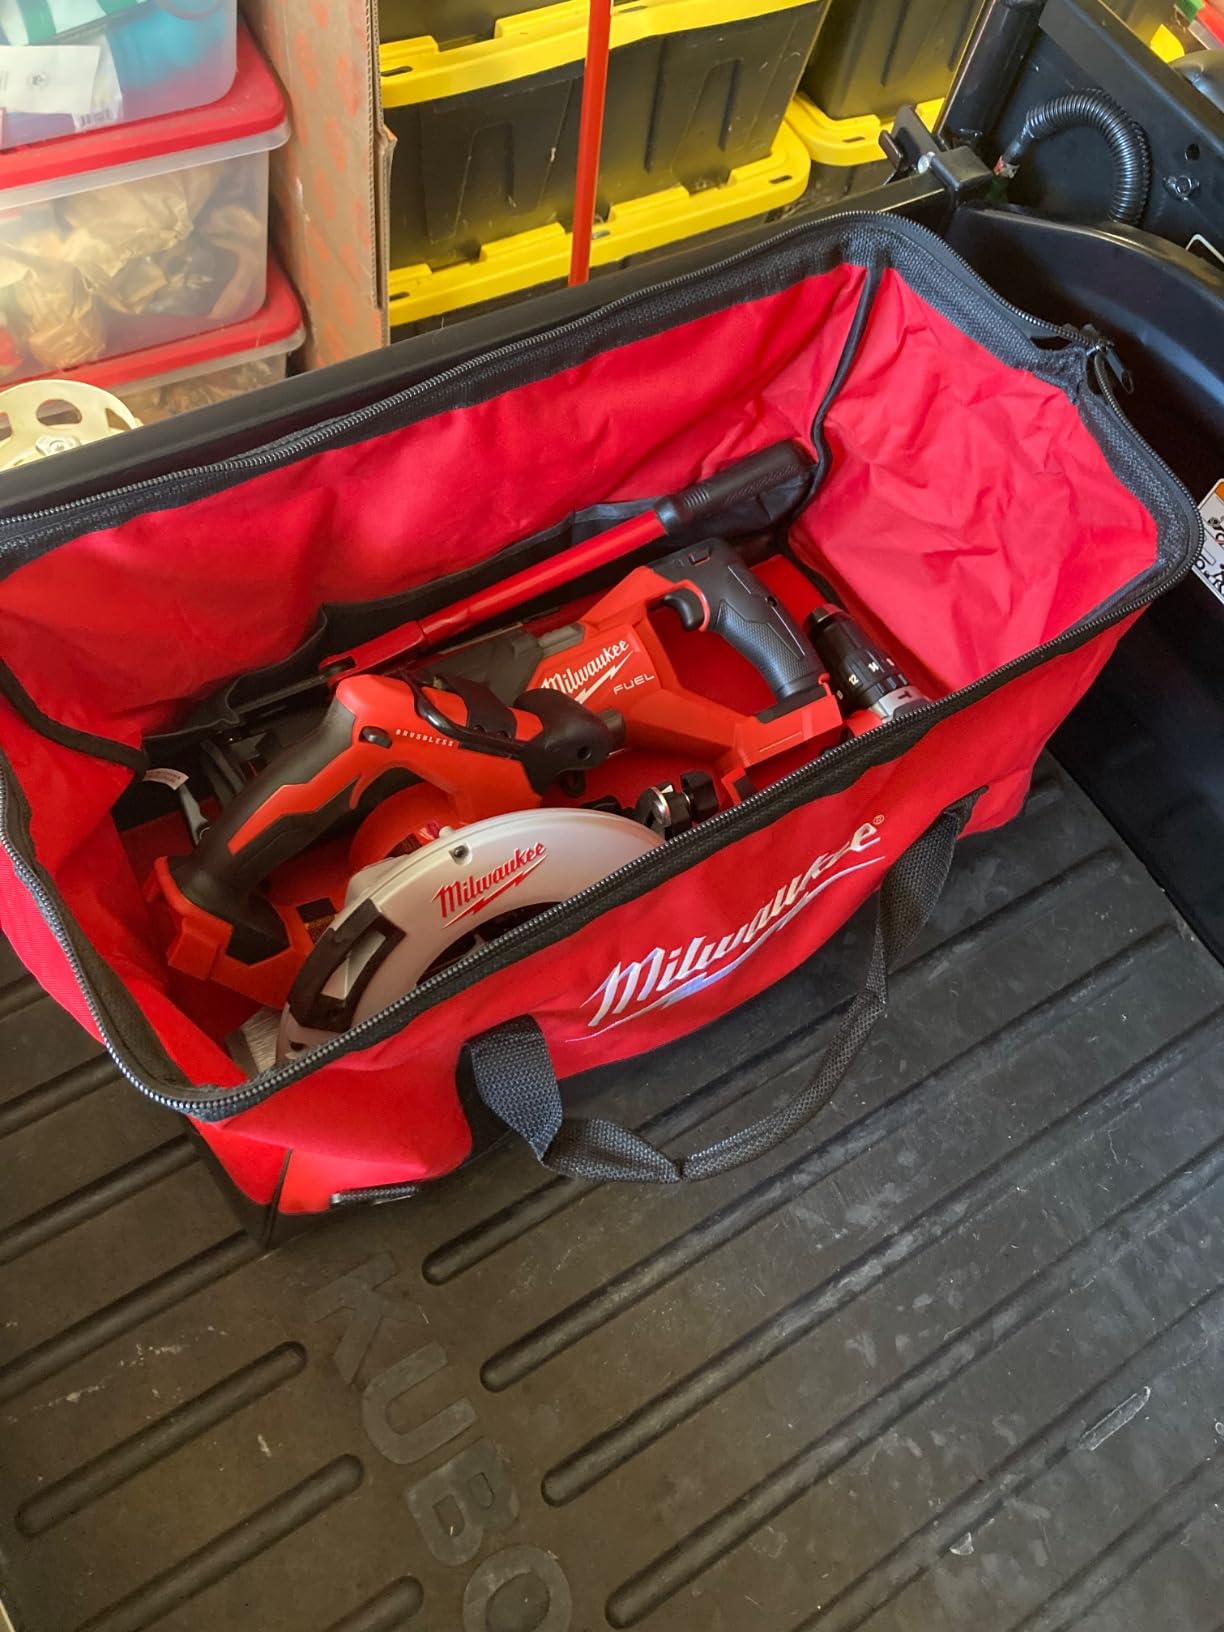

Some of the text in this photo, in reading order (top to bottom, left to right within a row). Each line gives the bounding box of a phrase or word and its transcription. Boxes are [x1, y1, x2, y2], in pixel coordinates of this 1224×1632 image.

[613, 673, 655, 695] FUEL
[848, 673, 859, 686] 12
[395, 728, 454, 747] BRUSHLESS
[431, 842, 546, 918] Milwaukee
